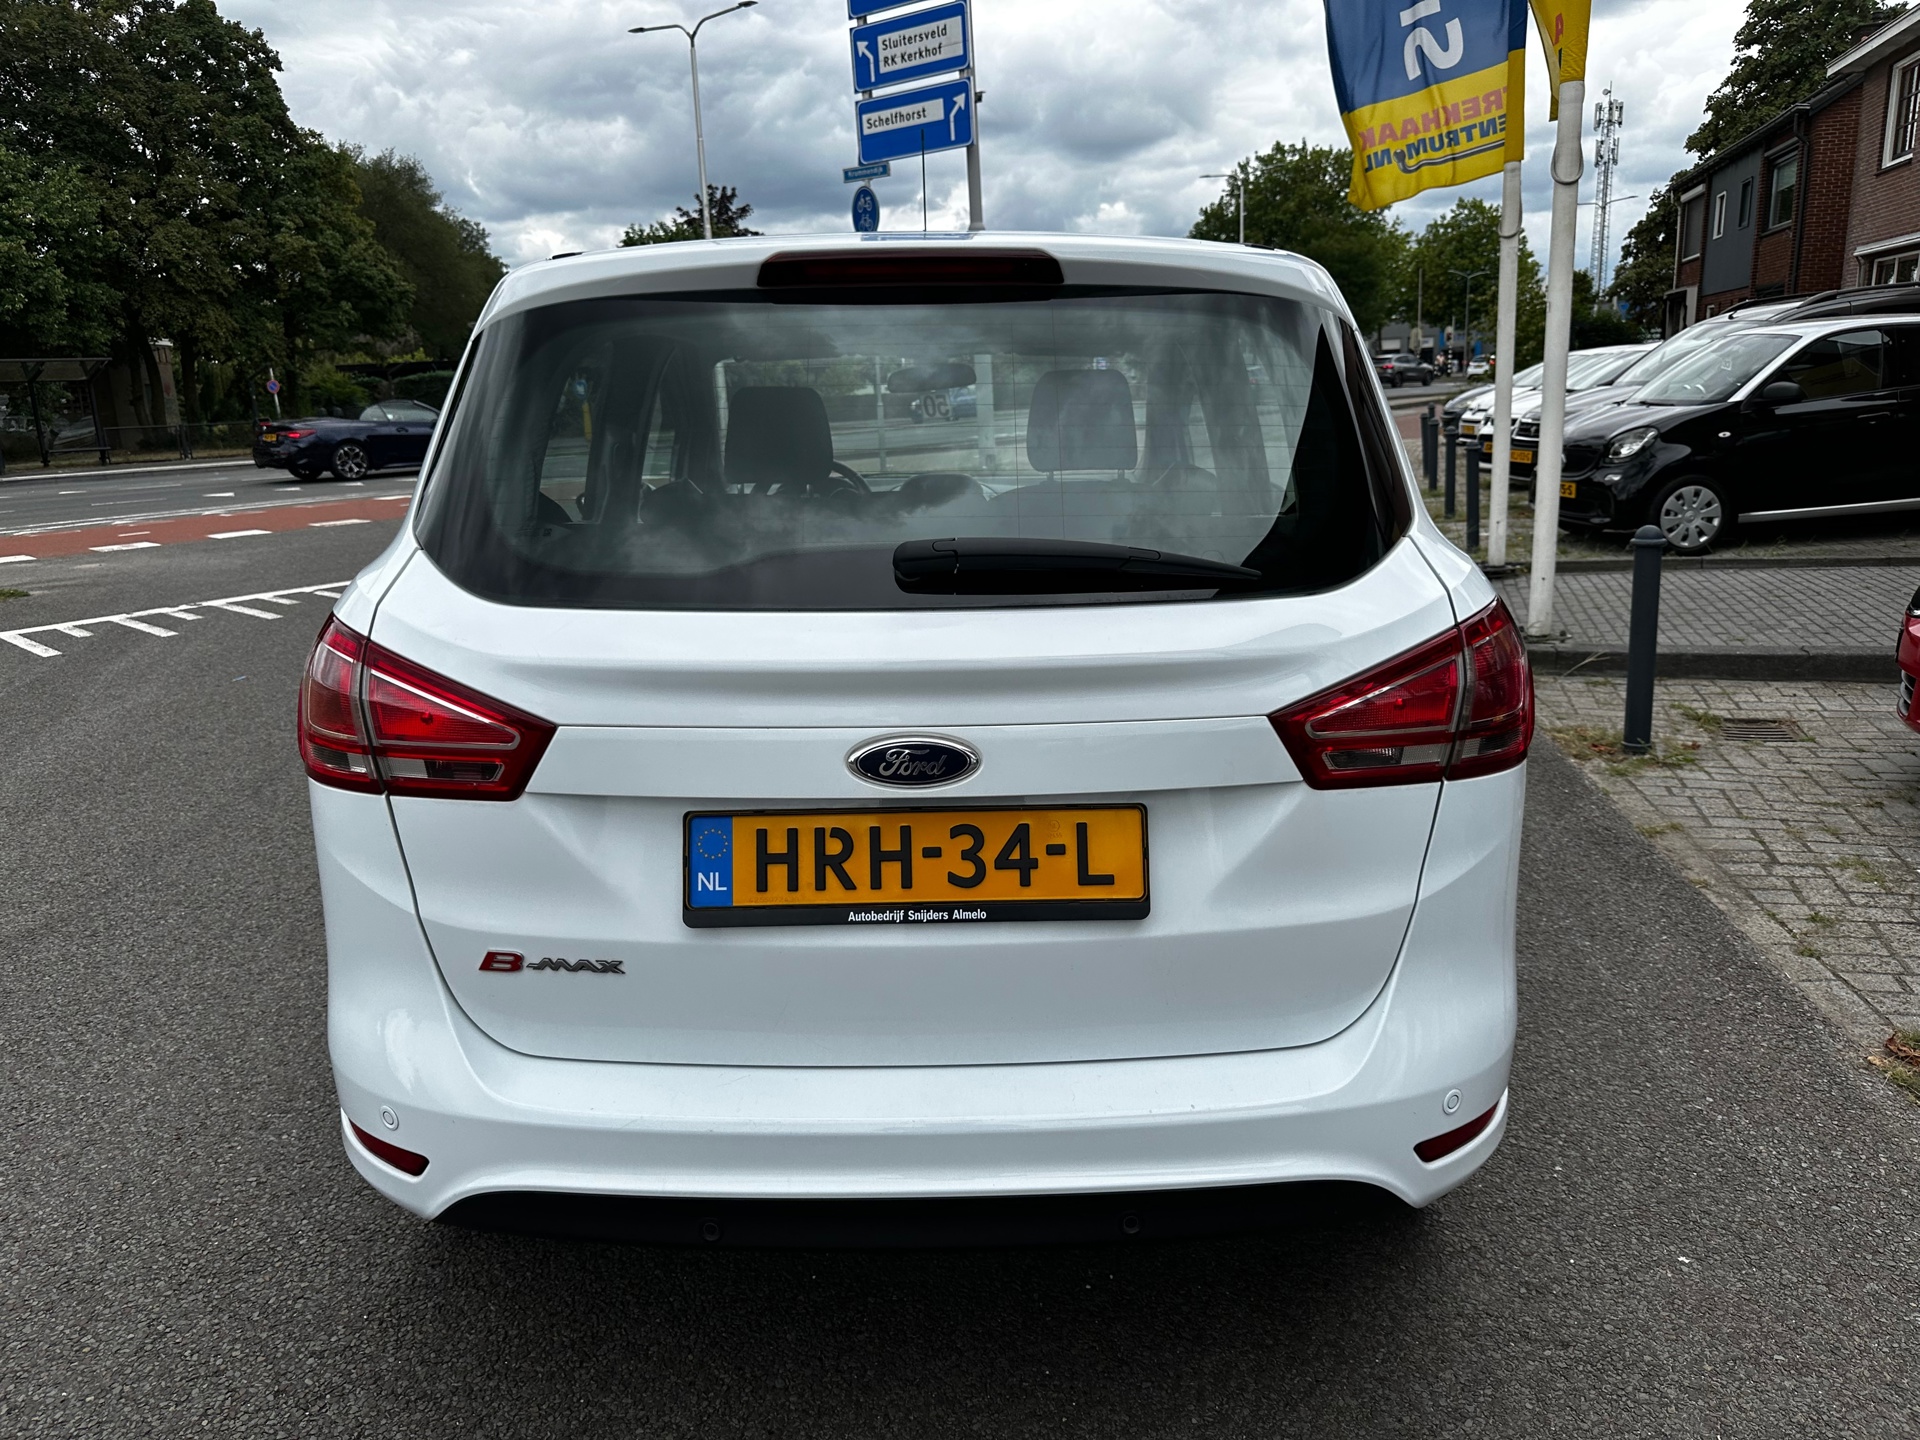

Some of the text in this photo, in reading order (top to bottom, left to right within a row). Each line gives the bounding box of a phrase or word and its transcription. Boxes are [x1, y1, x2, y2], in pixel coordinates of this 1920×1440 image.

[881, 24, 948, 51] Sluitersveld
[883, 42, 943, 68] RK Kerkhof
[866, 106, 928, 130] Schelfhorst
[878, 747, 949, 776] Ford
[755, 822, 1115, 892] HRH-34-L
[697, 872, 728, 892] NL
[847, 908, 987, 923] Autobedrijf Snijders Almelo
